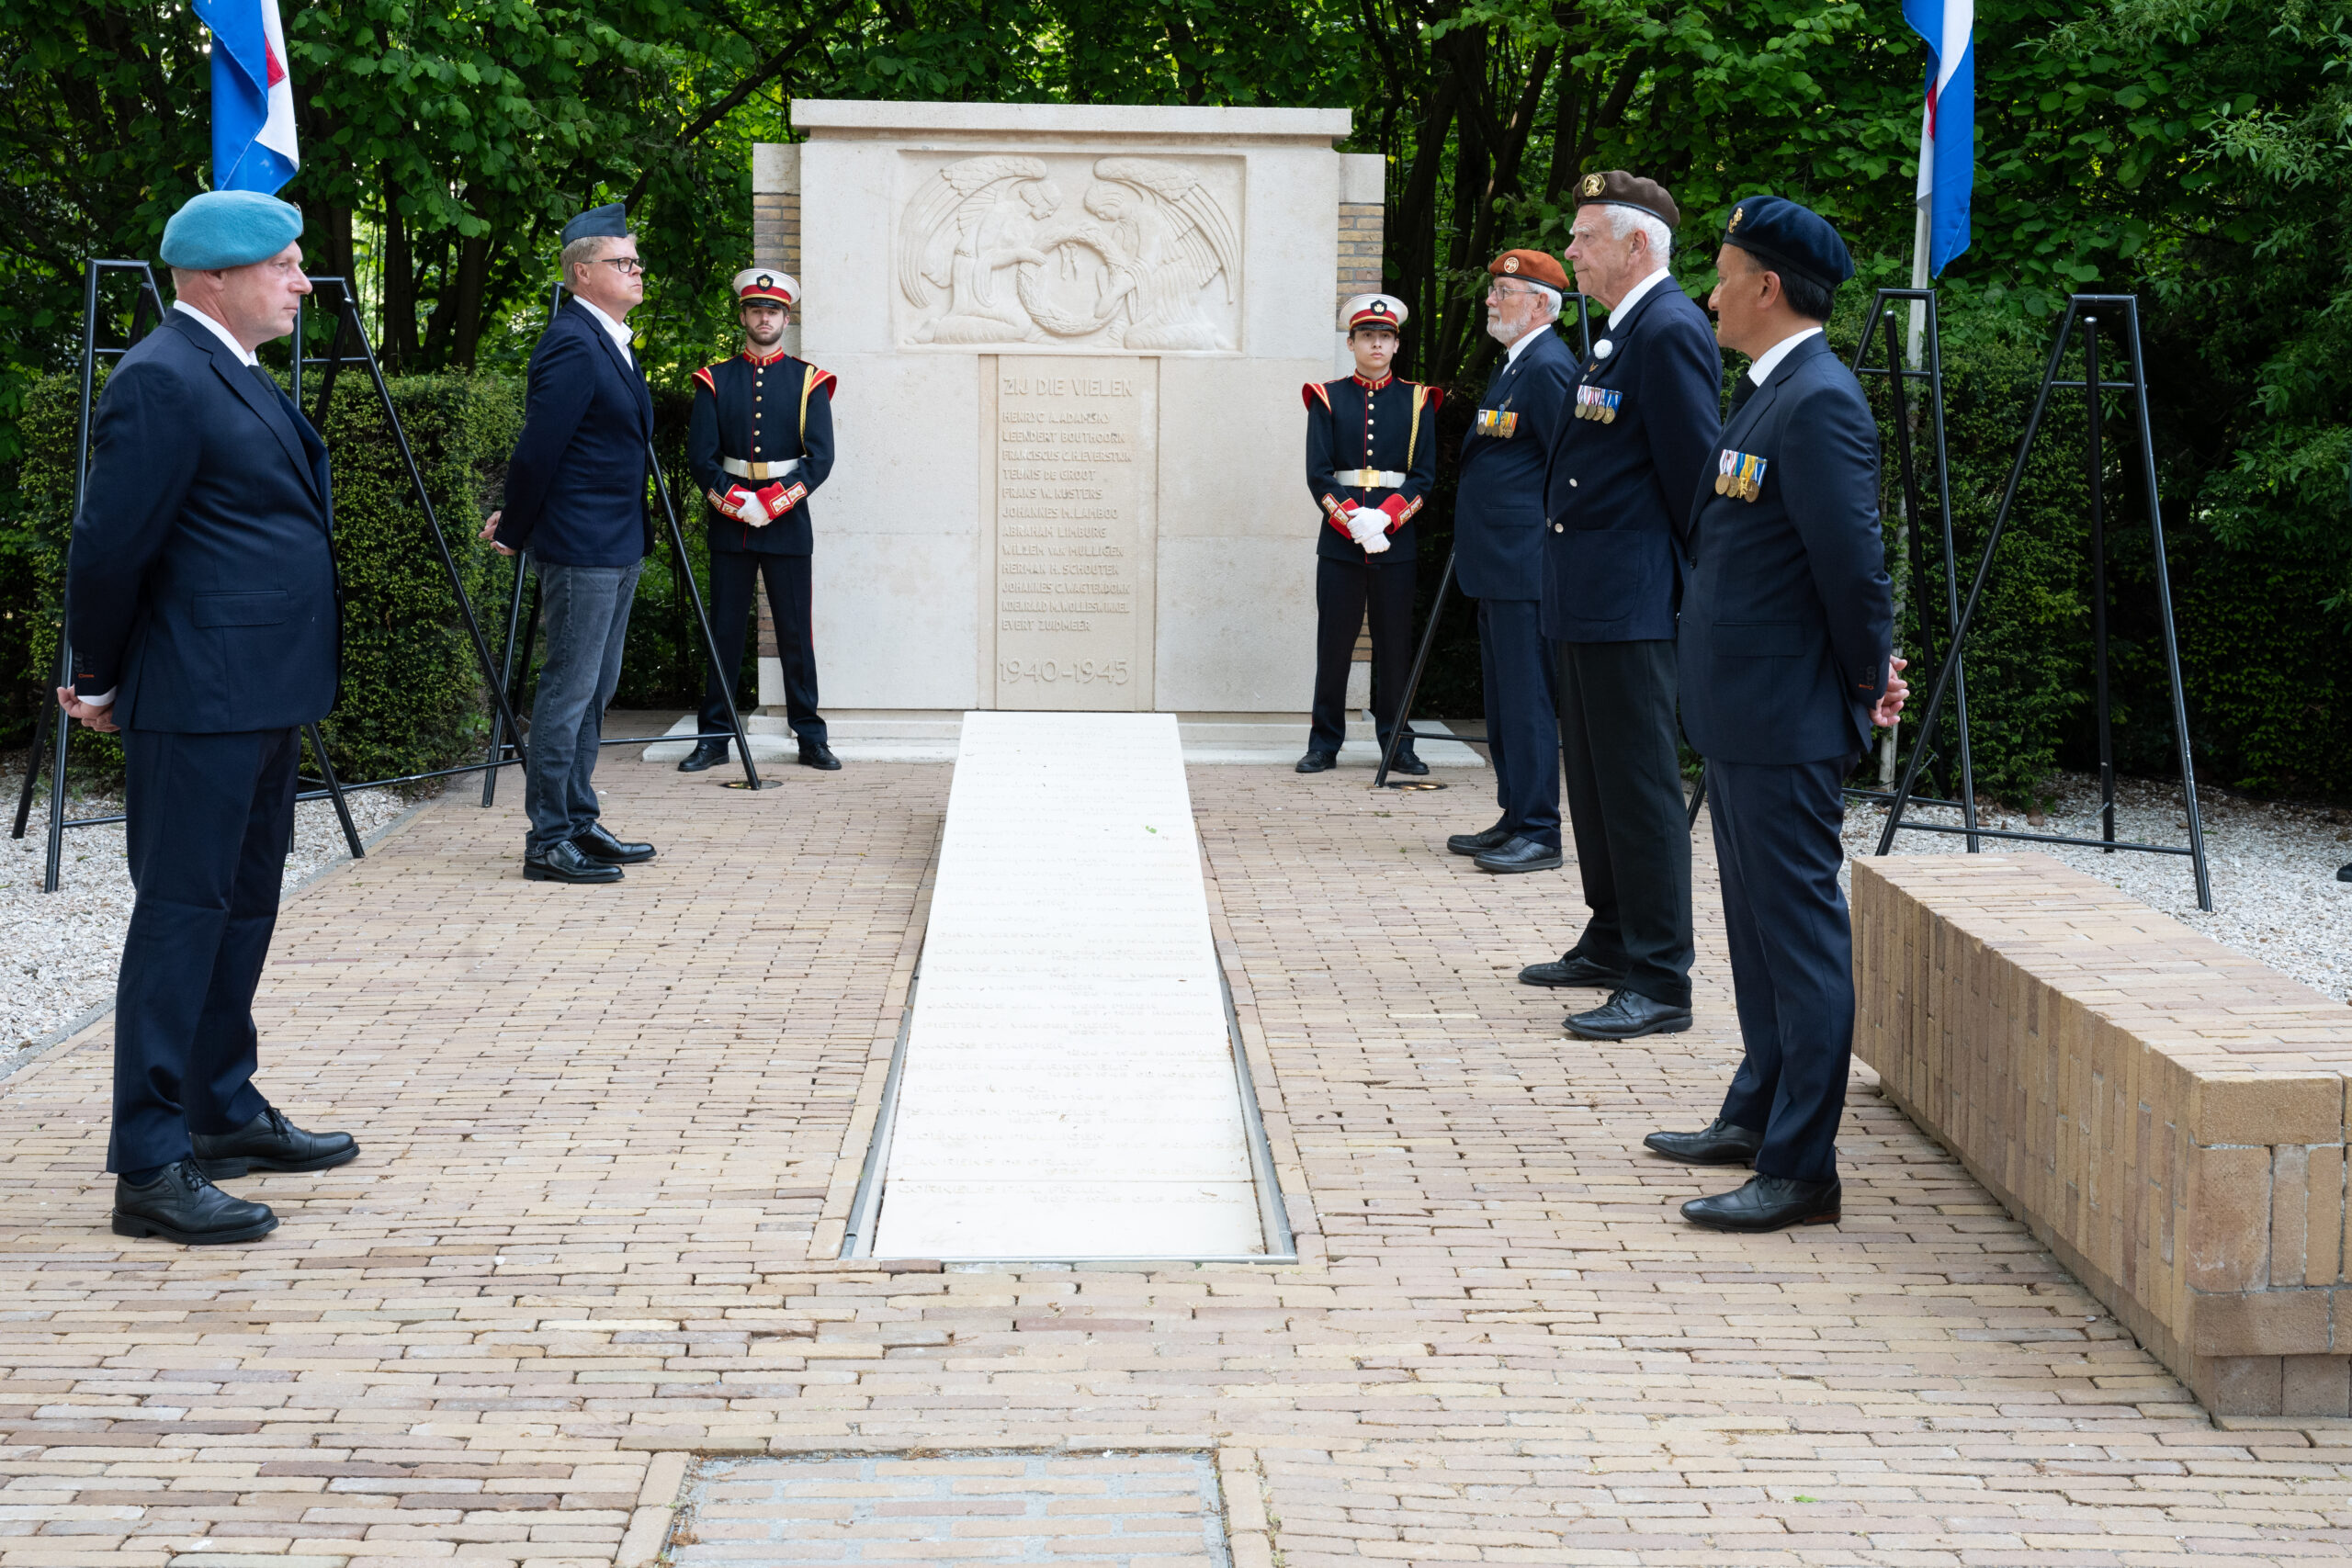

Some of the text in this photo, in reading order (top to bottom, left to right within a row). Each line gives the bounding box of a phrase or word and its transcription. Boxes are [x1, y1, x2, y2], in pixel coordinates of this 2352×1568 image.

[1003, 376, 1132, 397] ZIJ DIE VIELEN
[1002, 430, 1125, 444] LEENDERT BOUTHOORN
[1001, 450, 1059, 461] FRANCISCUS
[1002, 468, 1096, 480] TEUNIS DE GROOT
[1001, 487, 1037, 499] FRANS
[1001, 506, 1058, 518] JOHANNES
[1002, 525, 1107, 537] ABRAHAM LIMBURG
[1001, 544, 1044, 556] WILLEM
[1069, 546, 1124, 557] MULLIGEN
[1001, 563, 1046, 574] HERMAN
[1001, 581, 1051, 593] JOHANNES
[1001, 618, 1091, 631] EVERT ZUIDMEER
[1000, 658, 1130, 684] 1940-1945
